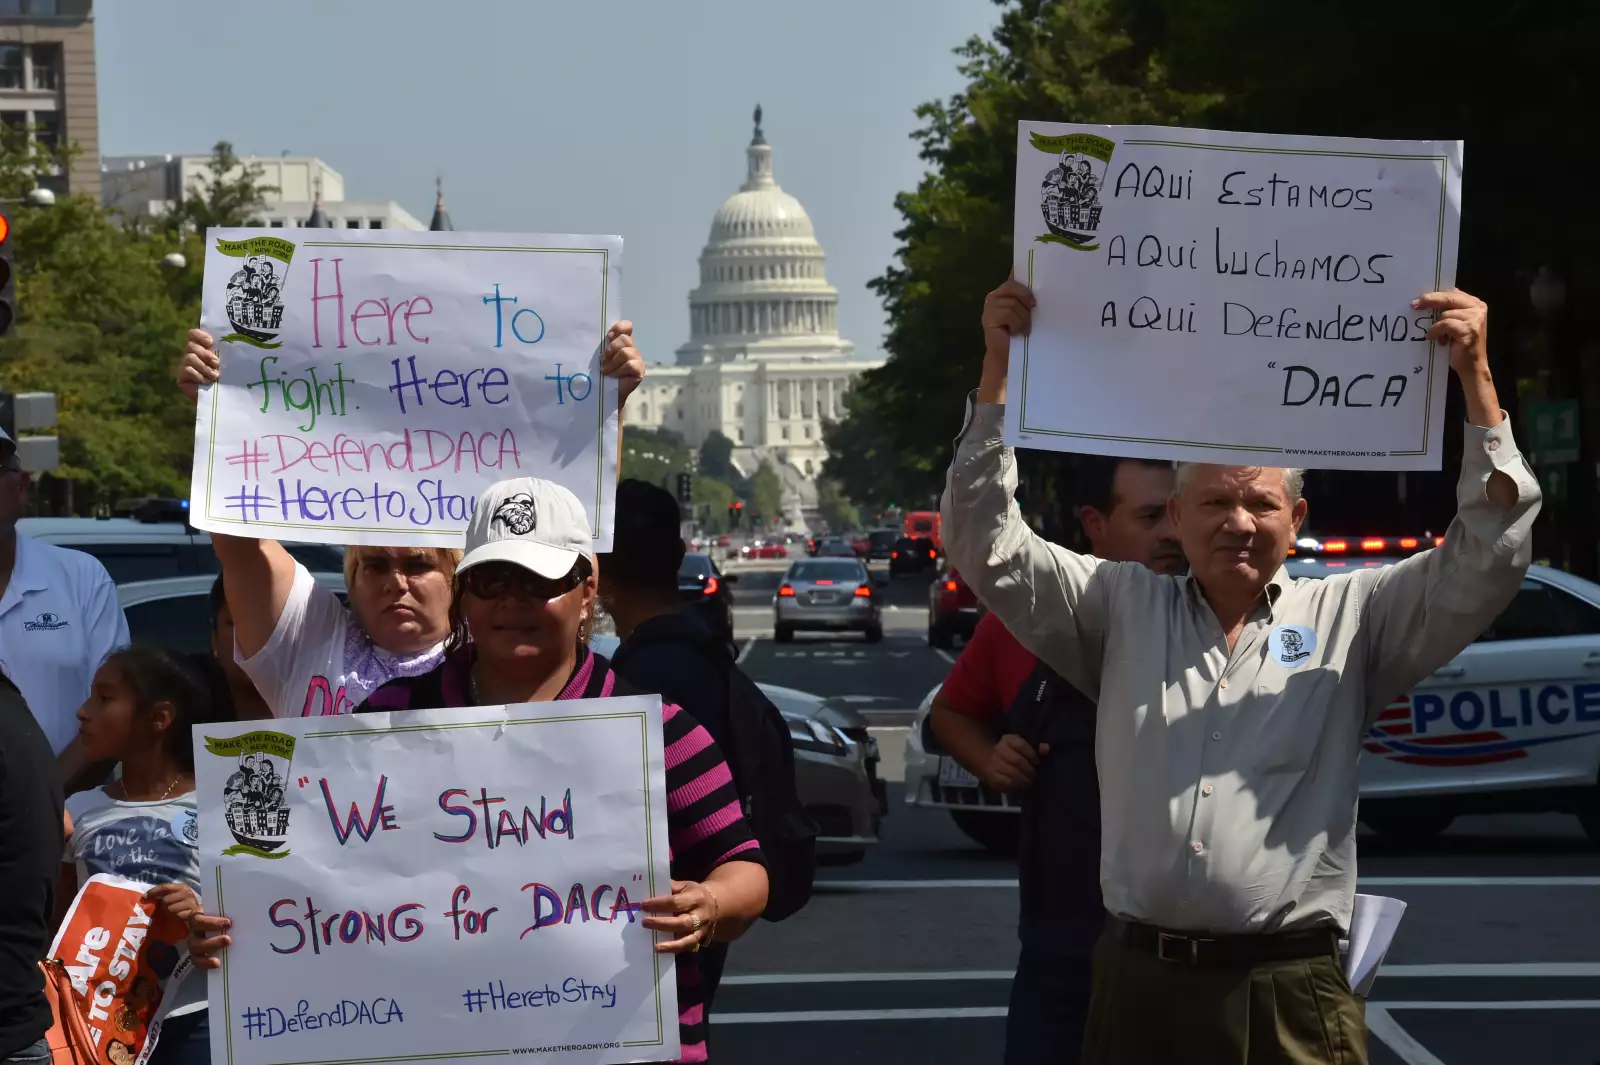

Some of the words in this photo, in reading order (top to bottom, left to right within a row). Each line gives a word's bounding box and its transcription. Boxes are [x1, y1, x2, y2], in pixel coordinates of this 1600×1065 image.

[1037, 138, 1065, 146] MAKE
[1066, 136, 1085, 145] THE
[1085, 137, 1113, 151] ROAD
[224, 242, 249, 251] MAKE
[249, 239, 265, 247] THE
[268, 241, 293, 252] ROAD
[272, 248, 289, 259] YORK
[309, 258, 433, 348] Here
[389, 355, 509, 414] Here
[545, 362, 592, 404] to
[225, 427, 521, 481] #DefendDACA
[1285, 448, 1387, 457] WWW.MAKETHEROADNY.ORG
[1412, 683, 1600, 733] POLICE
[214, 740, 242, 750] MAKE
[243, 734, 261, 744] THE
[264, 734, 293, 747] ROAD
[270, 743, 290, 754] YORK
[95, 828, 140, 856] Love
[129, 847, 159, 863] the
[443, 885, 498, 940] for
[63, 926, 111, 997] Are
[88, 980, 117, 1021] TO
[108, 903, 152, 981] STAY
[241, 998, 404, 1040] #DefendDACA
[512, 1042, 621, 1055] WWW.MAKETHEROADNY.ORG
